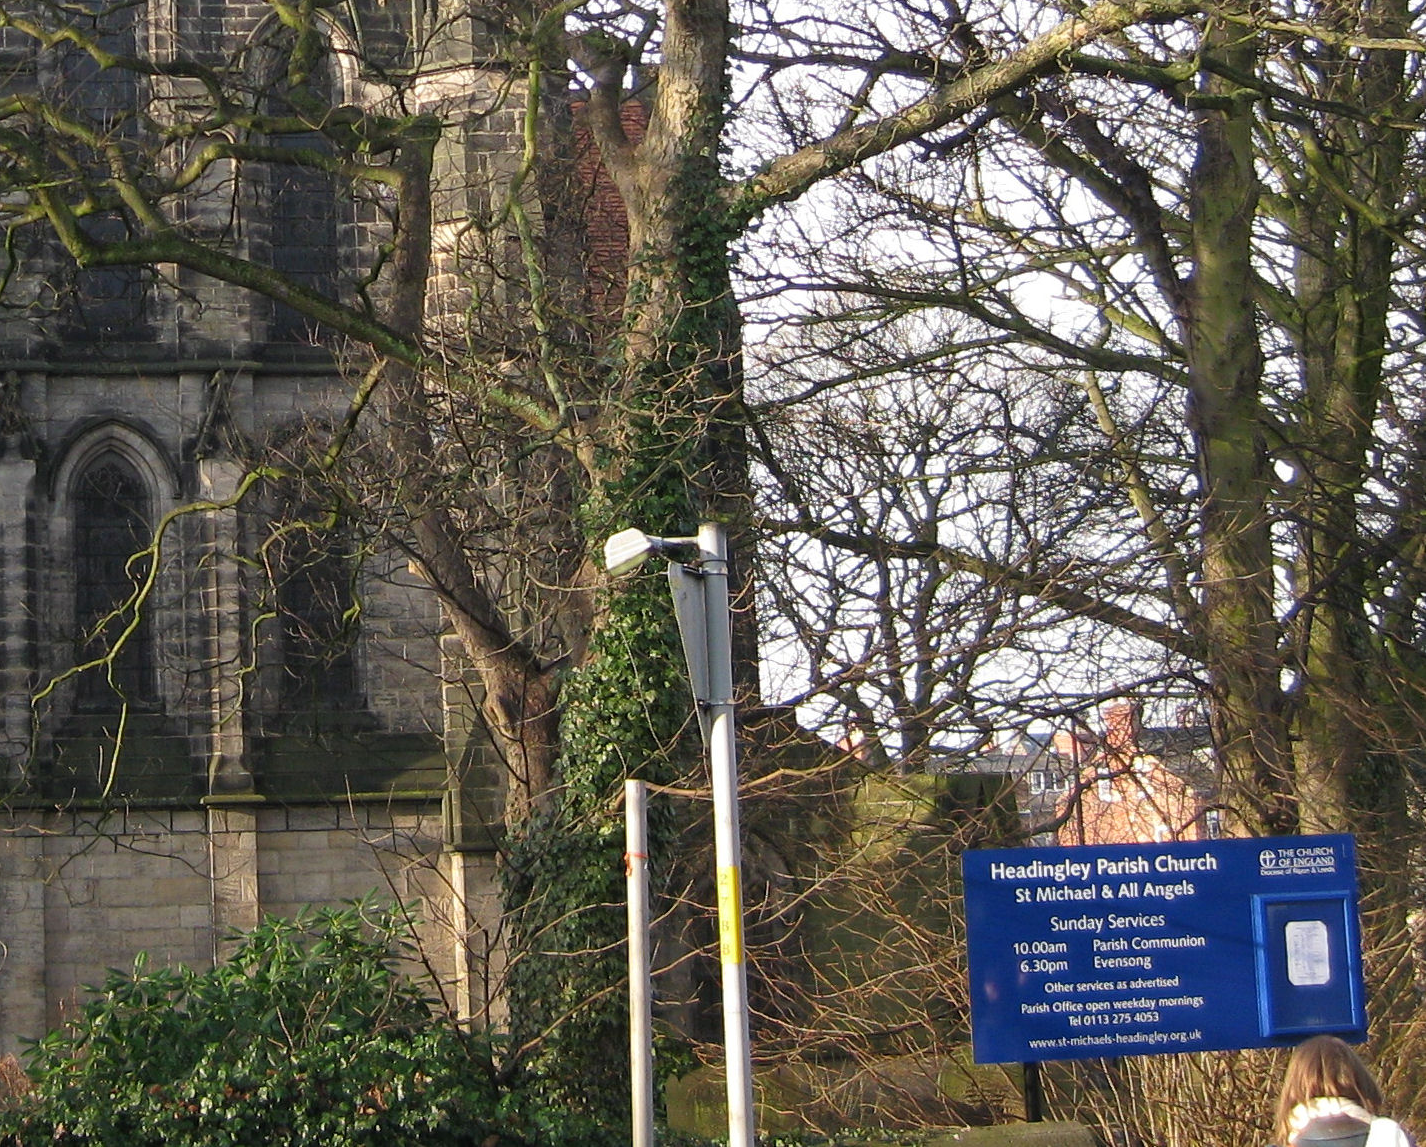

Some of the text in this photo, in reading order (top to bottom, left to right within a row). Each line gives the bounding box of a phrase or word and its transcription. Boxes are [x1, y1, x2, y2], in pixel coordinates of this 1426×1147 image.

[1278, 847, 1334, 857] THE CHURCH
[991, 853, 1217, 881] Headingley Parish Church
[1278, 856, 1335, 867] OF ENGLAND
[1015, 880, 1195, 903] St Michael & All Angels
[1050, 913, 1165, 933] Sunday Services
[1013, 941, 1067, 954] 10.00am
[1093, 935, 1206, 951] Parish Communion
[1021, 960, 1068, 974] 6.30pm
[1094, 956, 1152, 969] Evensong
[1044, 976, 1178, 993] Other services as advertised
[1021, 995, 1204, 1014] Parish Office open weekday mornings
[1069, 1012, 1159, 1026] Tel 0113 275 4053
[1029, 1029, 1201, 1049] www.st-michaels-headingley.org.uk
